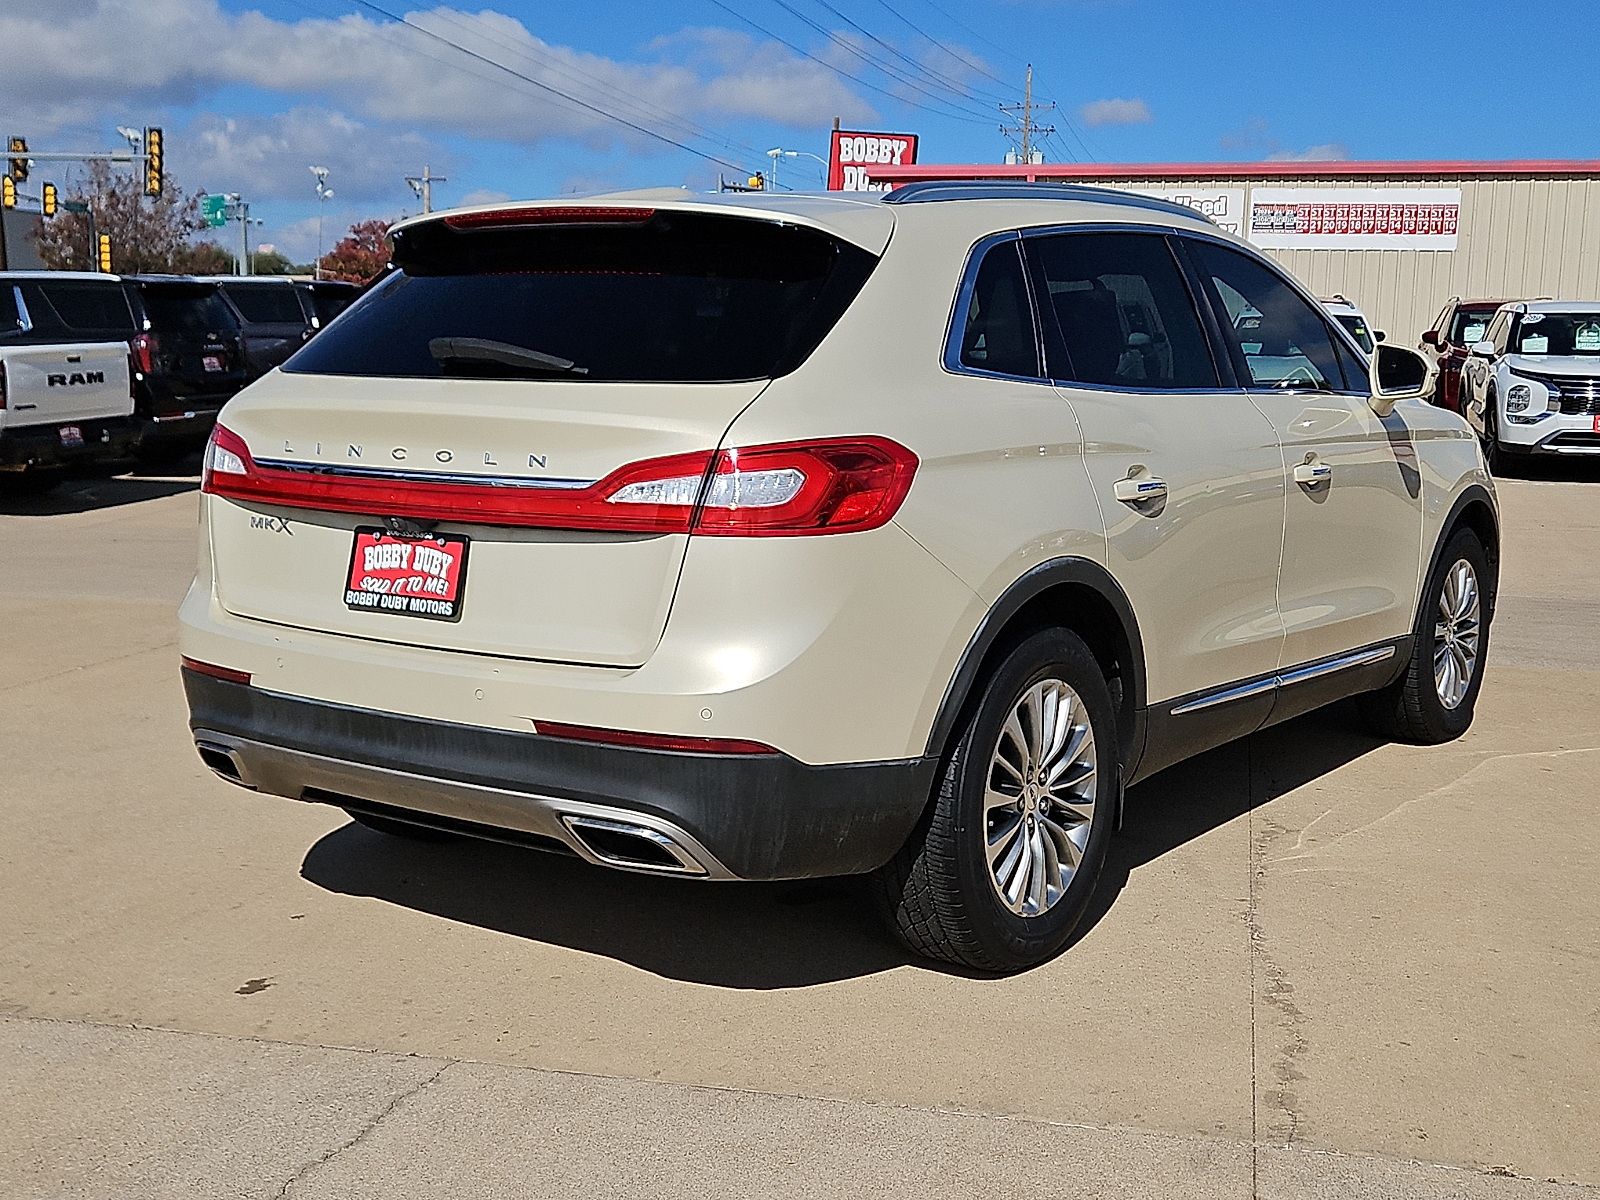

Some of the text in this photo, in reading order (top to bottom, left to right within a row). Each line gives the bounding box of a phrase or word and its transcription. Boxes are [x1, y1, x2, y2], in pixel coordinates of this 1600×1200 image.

[839, 137, 907, 165] BOBBY
[47, 371, 104, 387] RAM
[284, 440, 547, 468] LINCOLN
[250, 516, 294, 536] MKX
[364, 543, 454, 579] BOBBY DUBY
[360, 576, 449, 597] SOLD IT TO ME!
[346, 590, 453, 616] BOBBY DUBY MOTORS
